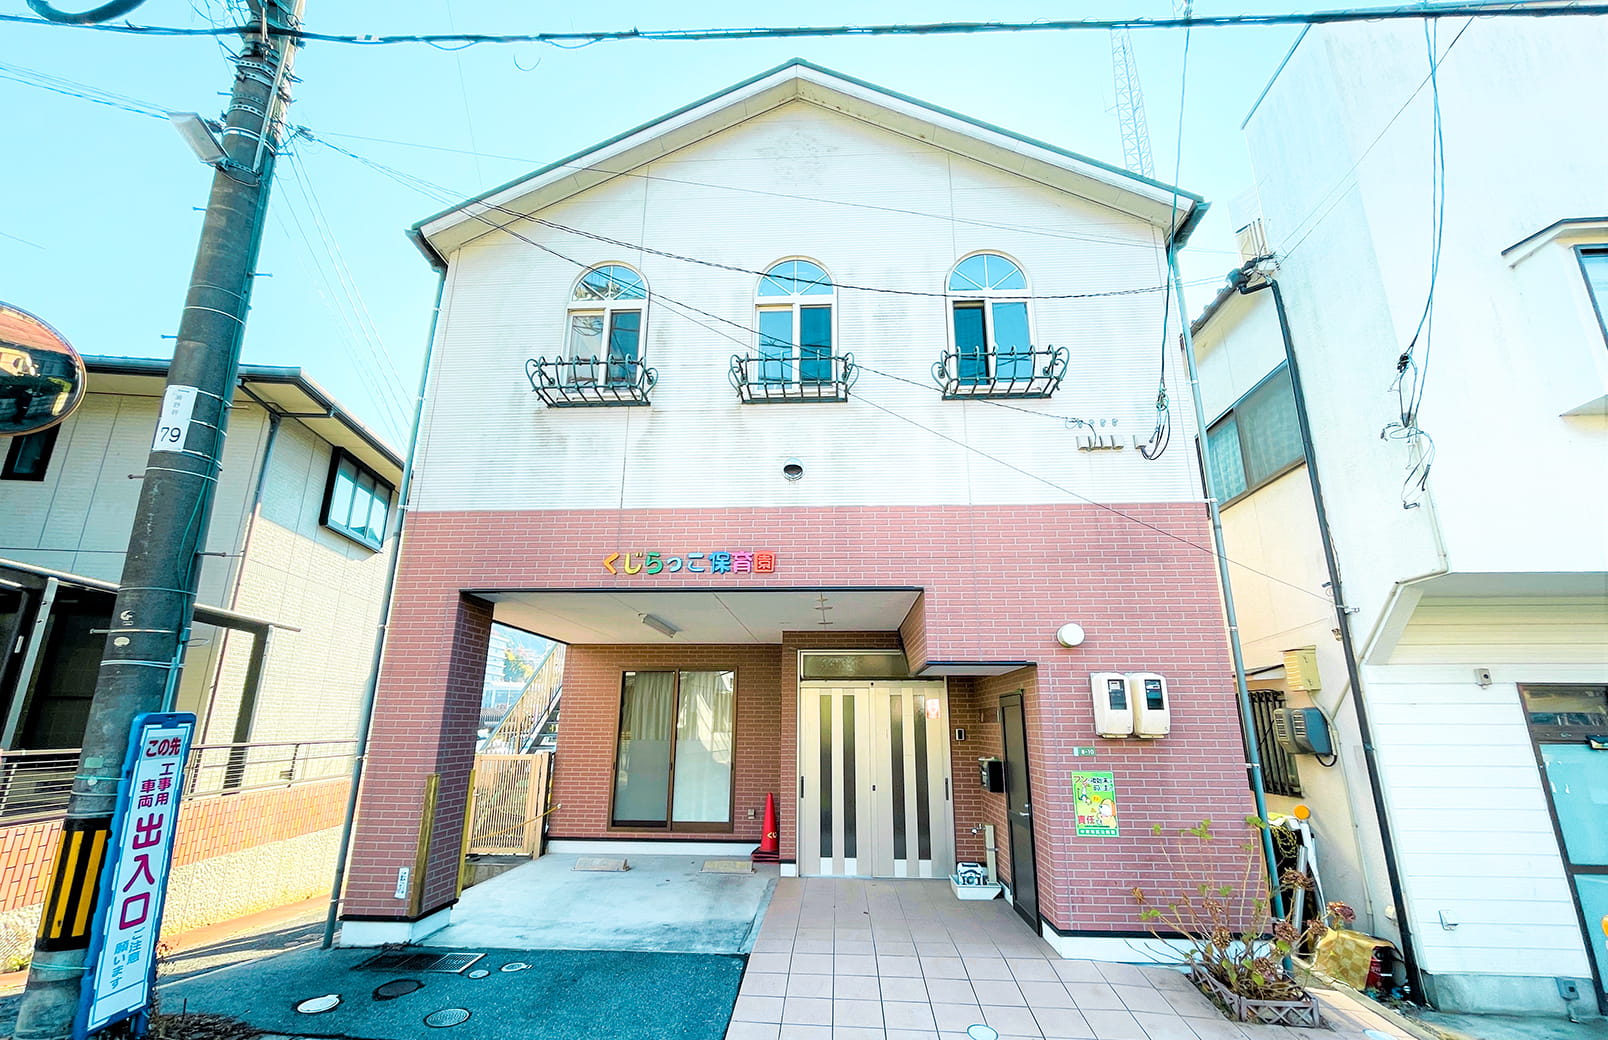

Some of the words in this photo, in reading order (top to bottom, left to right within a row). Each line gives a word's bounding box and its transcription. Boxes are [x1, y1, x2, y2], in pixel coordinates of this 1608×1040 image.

[160, 426, 182, 443] 79
[603, 551, 776, 575] くじらっこ保育園
[146, 737, 181, 757] この先
[137, 779, 156, 809] 車両
[155, 762, 175, 806] 工事用
[118, 812, 164, 931] 出入口
